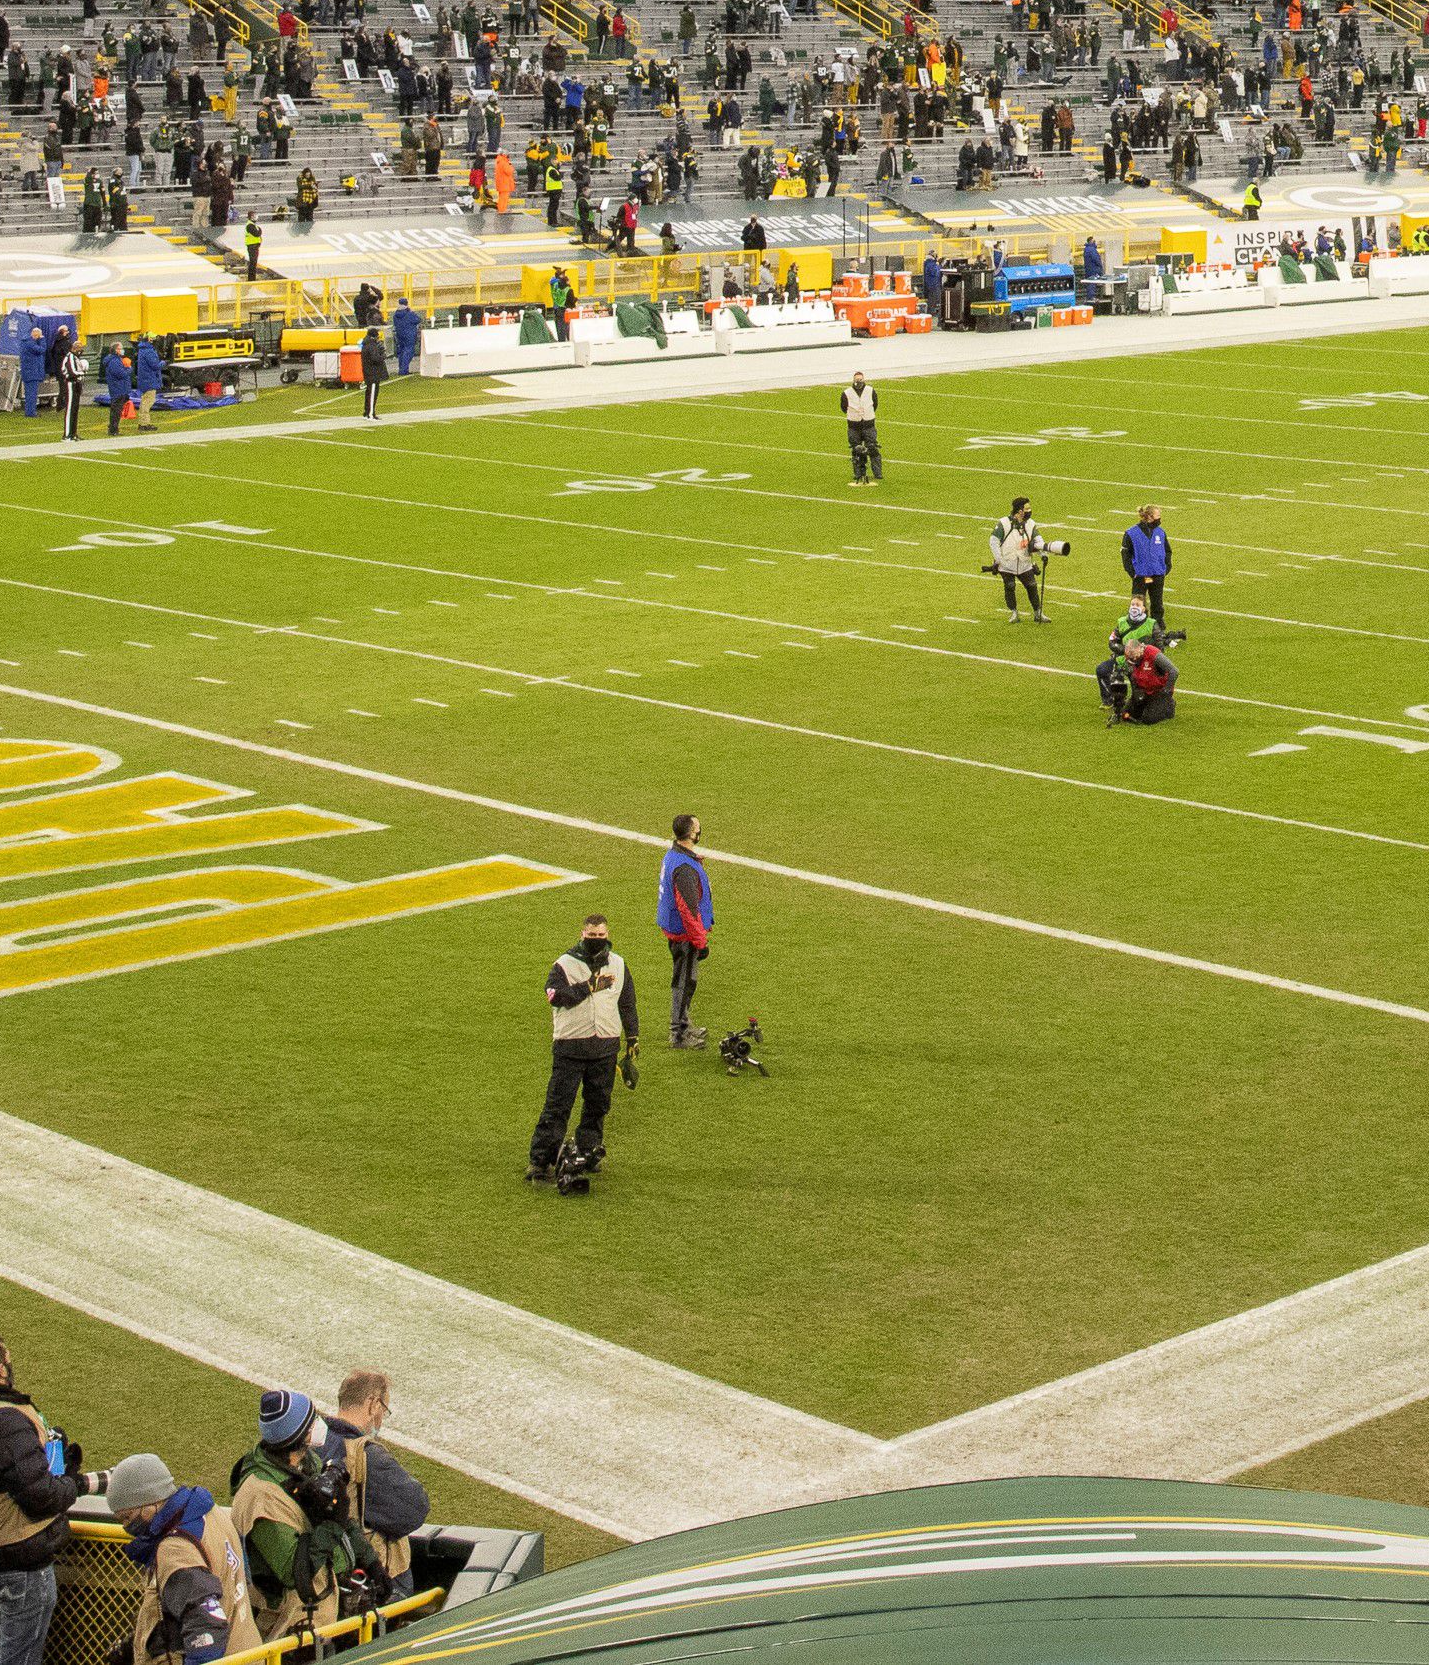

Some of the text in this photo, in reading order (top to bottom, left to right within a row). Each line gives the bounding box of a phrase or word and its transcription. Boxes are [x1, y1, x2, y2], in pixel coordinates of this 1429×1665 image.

[989, 194, 1123, 217] PACKERS
[321, 227, 484, 254] PACKERS
[809, 226, 868, 242] LINES
